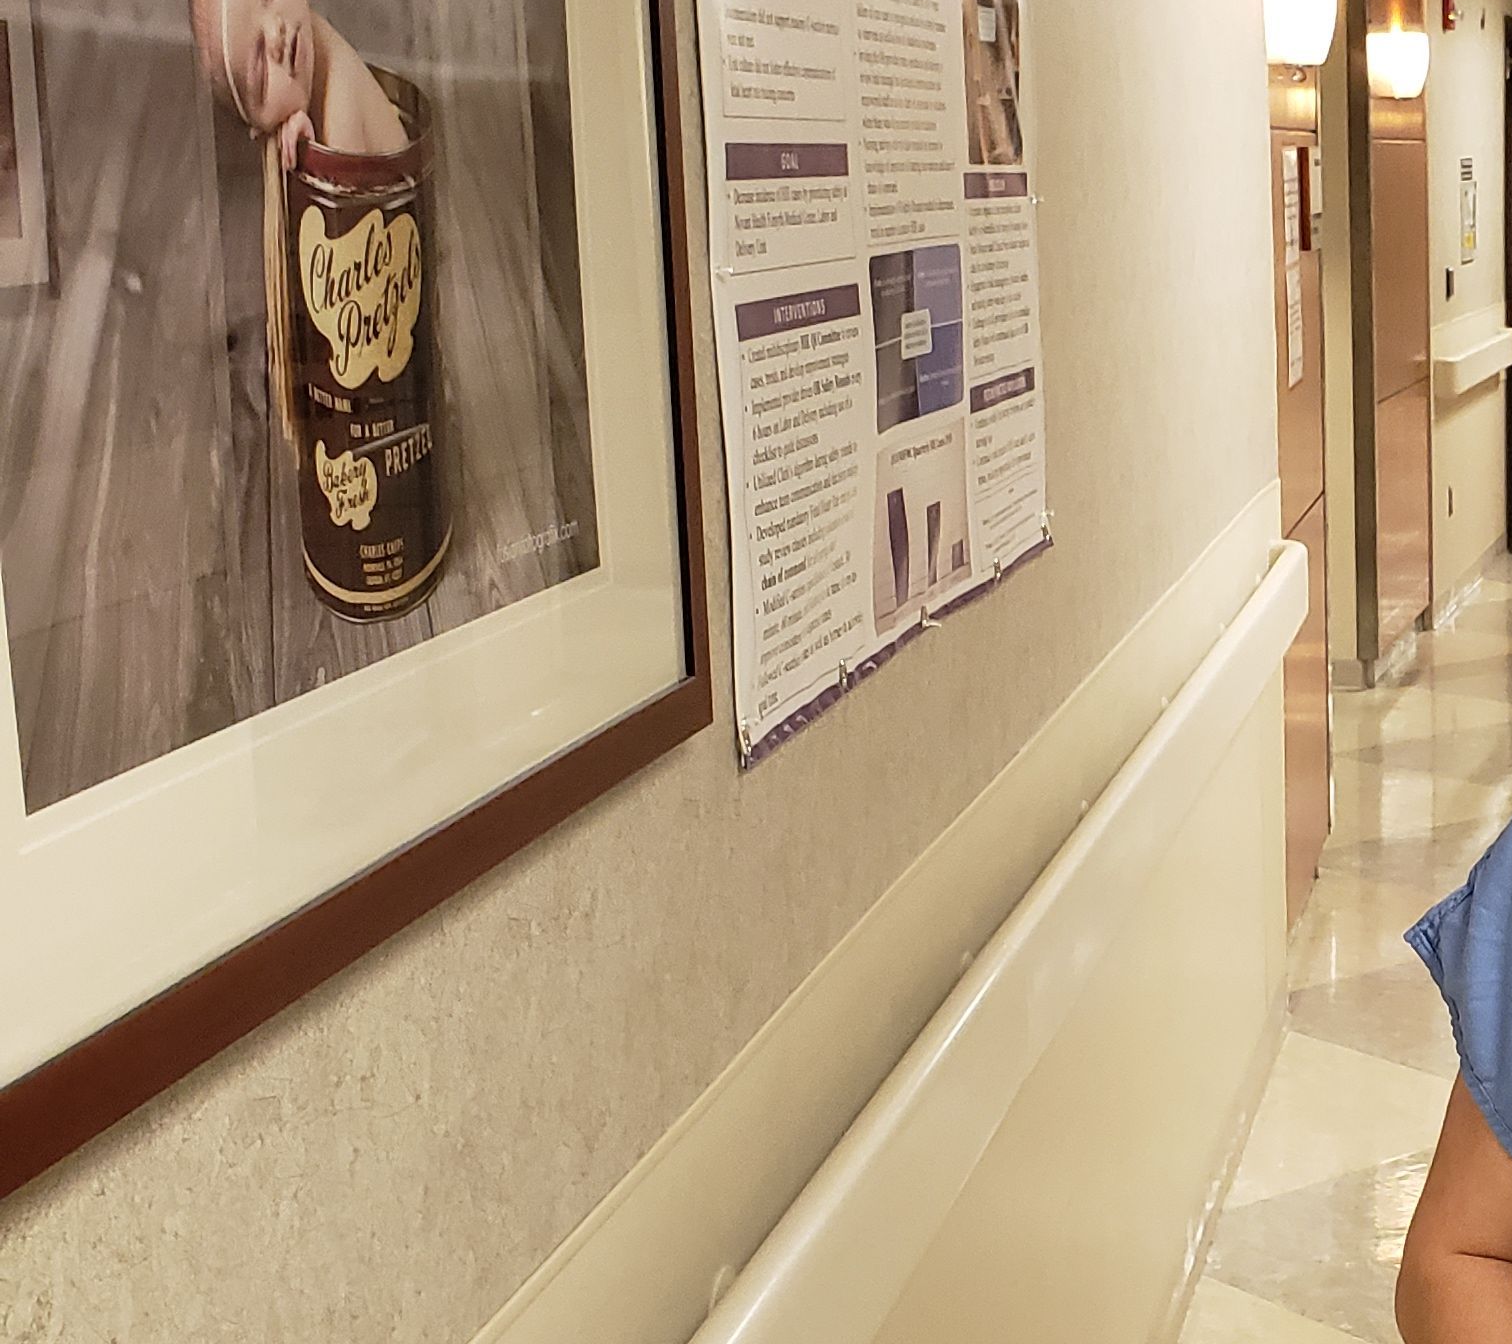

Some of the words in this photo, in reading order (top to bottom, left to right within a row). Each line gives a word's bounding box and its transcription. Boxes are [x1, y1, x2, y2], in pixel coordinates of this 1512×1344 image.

[780, 151, 798, 170] GOAL
[310, 223, 393, 313] Charles
[336, 229, 420, 376] Pretzels
[774, 298, 826, 324] INTERVENTIONS
[385, 424, 434, 476] PRETZEL
[323, 460, 367, 493] Bakery
[336, 477, 369, 518] Fresh
